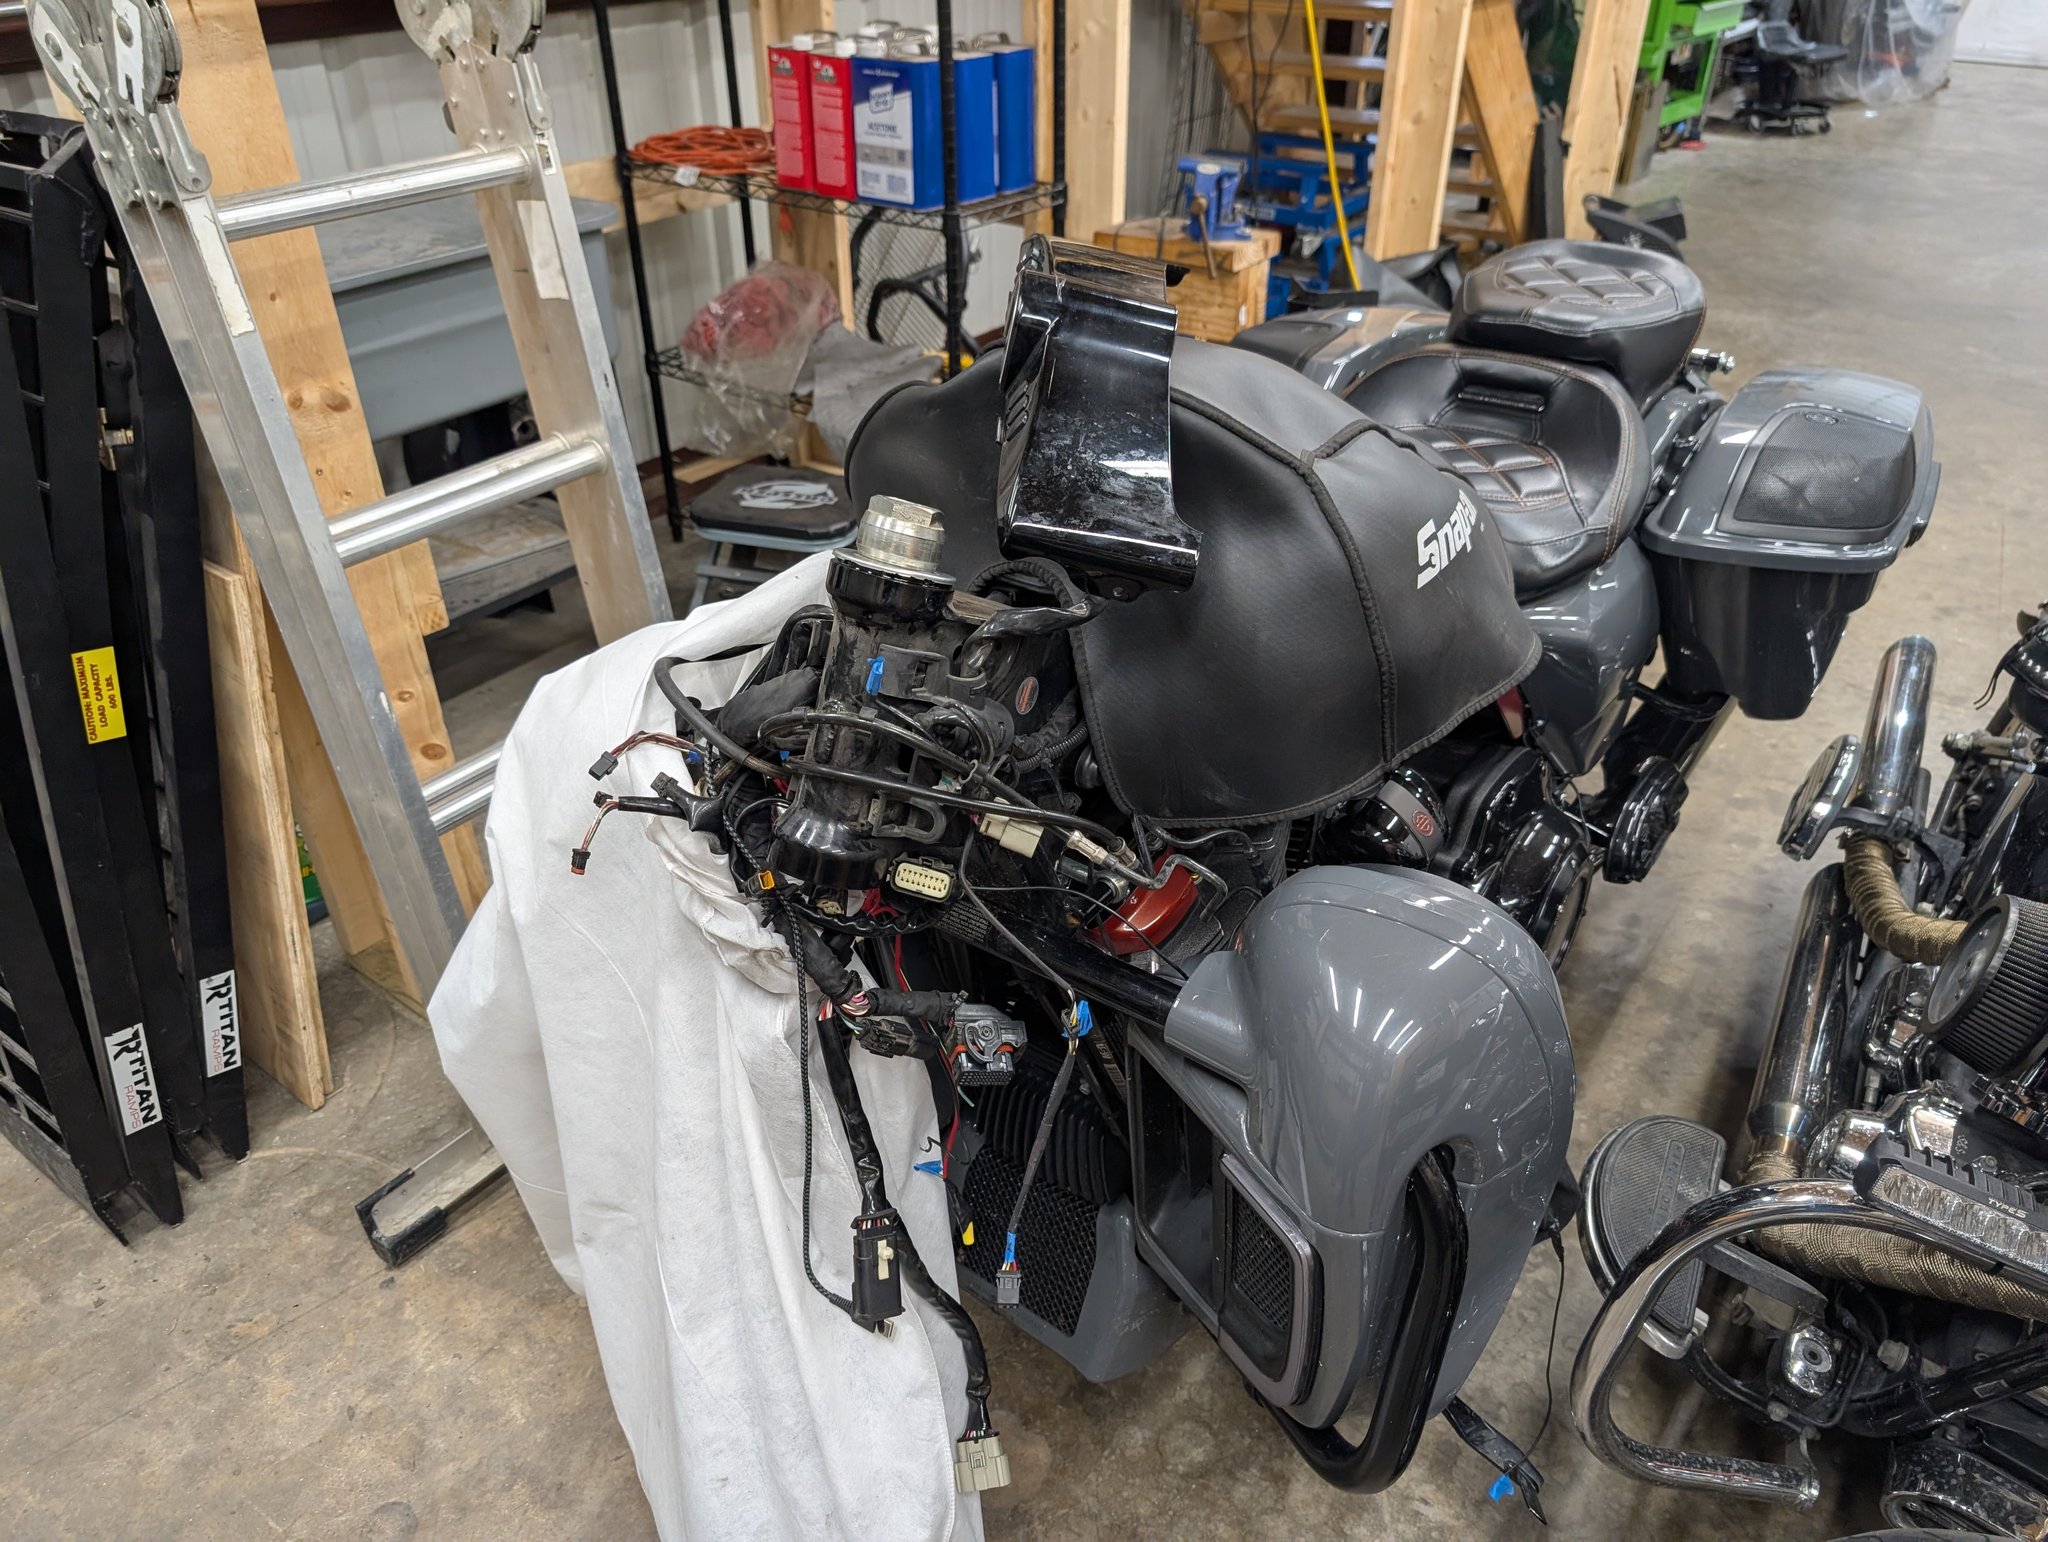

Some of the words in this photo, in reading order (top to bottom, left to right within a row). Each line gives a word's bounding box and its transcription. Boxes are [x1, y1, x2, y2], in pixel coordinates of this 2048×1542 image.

[75, 656, 90, 699] MAXIMUM
[90, 664, 103, 701] CAPACITY
[105, 674, 114, 691] LBS.
[84, 701, 97, 741] CAUTION:
[97, 705, 108, 727] LOAD
[108, 694, 117, 709] 600
[211, 1029, 222, 1072] RAMPS
[219, 997, 237, 1068] TITAN
[124, 1084, 141, 1129] RAMPS
[129, 1050, 157, 1124] TITAN
